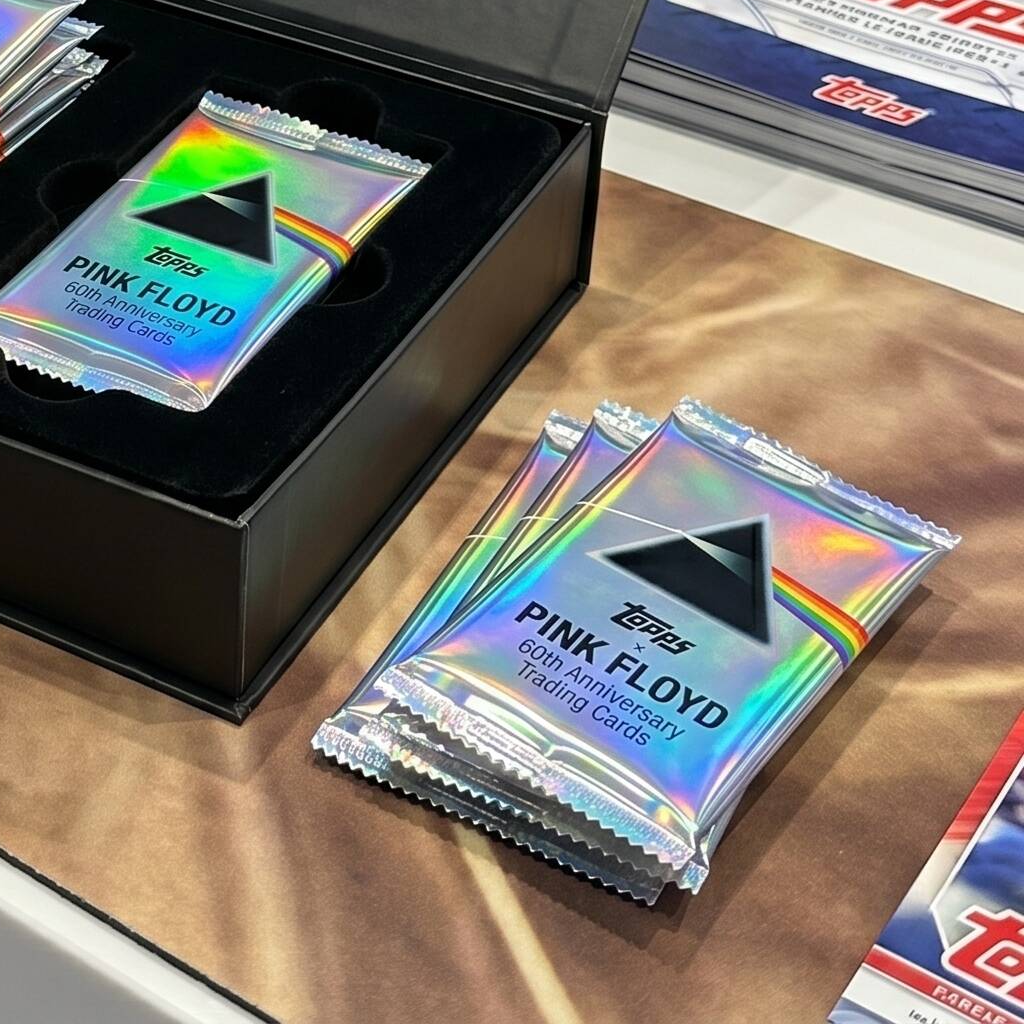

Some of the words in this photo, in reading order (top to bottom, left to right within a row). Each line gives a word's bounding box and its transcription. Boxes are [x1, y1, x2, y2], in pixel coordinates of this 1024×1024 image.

[812, 74, 929, 127] Topps
[144, 245, 210, 278] Topps
[63, 255, 141, 293] PINK
[137, 281, 236, 326] FLOYD
[64, 281, 102, 302] 60th
[103, 295, 202, 338] Anniversary
[65, 298, 125, 329] Trading
[127, 320, 176, 346] Cards
[610, 601, 697, 655] Topps
[514, 601, 610, 665] PINK
[605, 651, 729, 729] FLOYD
[518, 638, 564, 672] 60th
[564, 666, 686, 741] Anniversary
[517, 660, 589, 714] Trading
[592, 705, 651, 746] Cards
